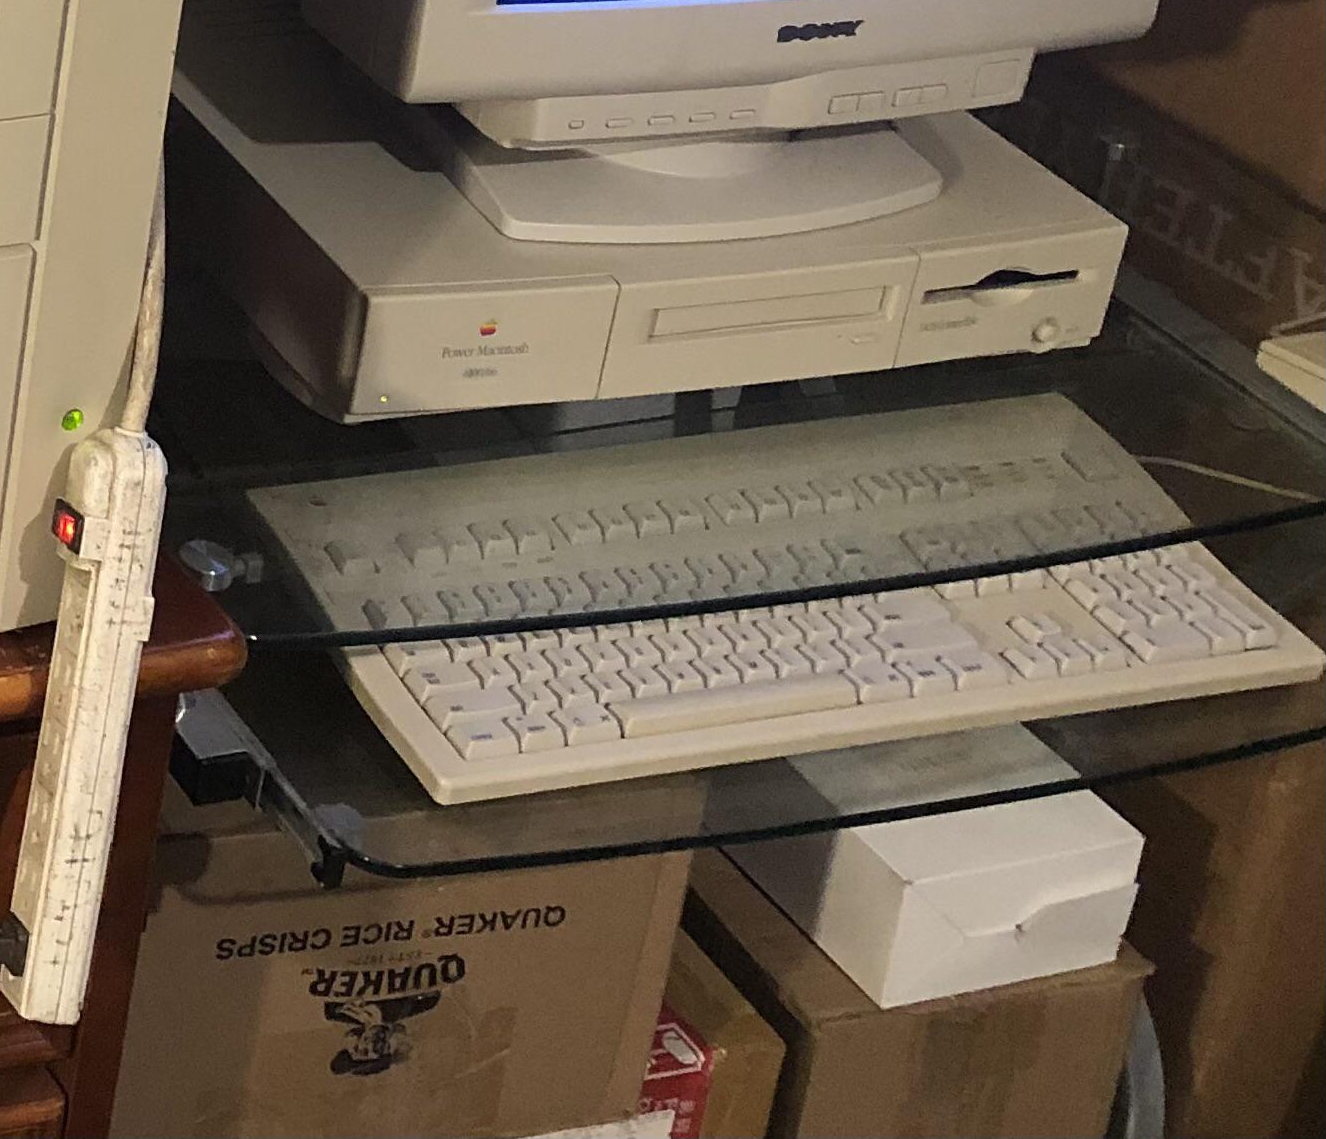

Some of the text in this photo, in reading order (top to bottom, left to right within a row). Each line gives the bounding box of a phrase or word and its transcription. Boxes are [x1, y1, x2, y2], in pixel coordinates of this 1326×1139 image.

[215, 905, 566, 960] QUAKER RICE CRISPS
[307, 953, 466, 998] QUAKER
